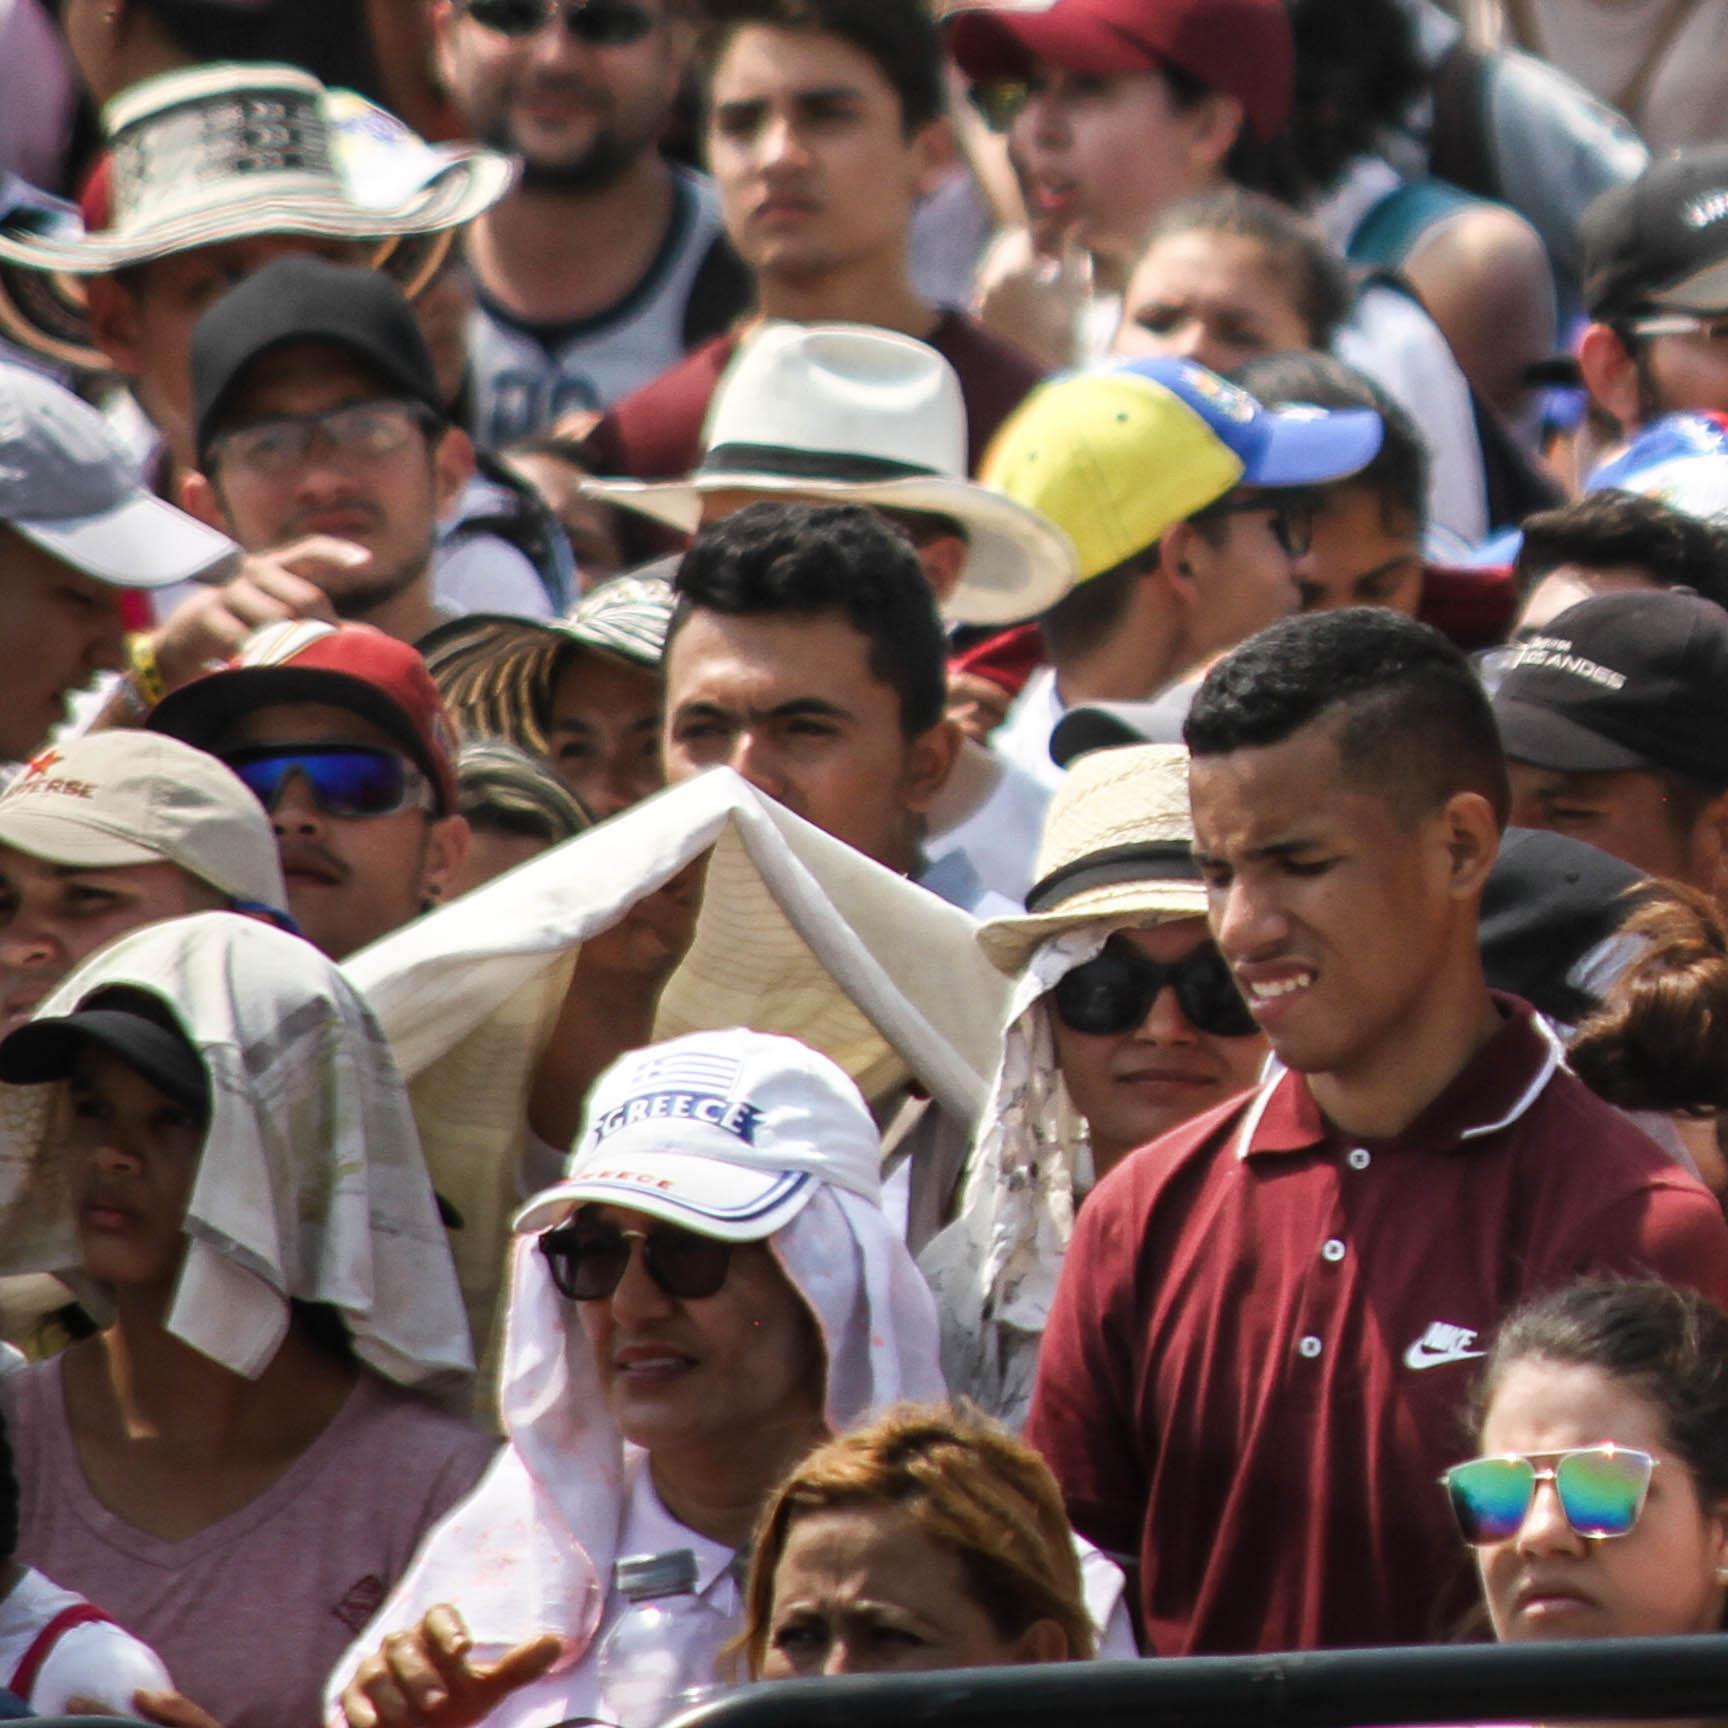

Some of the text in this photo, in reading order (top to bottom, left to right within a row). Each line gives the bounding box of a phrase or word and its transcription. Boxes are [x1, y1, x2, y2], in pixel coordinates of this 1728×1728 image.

[1544, 653, 1628, 691] ANDES
[598, 1093, 748, 1138] GREECE
[1422, 1320, 1479, 1353] NIKE
